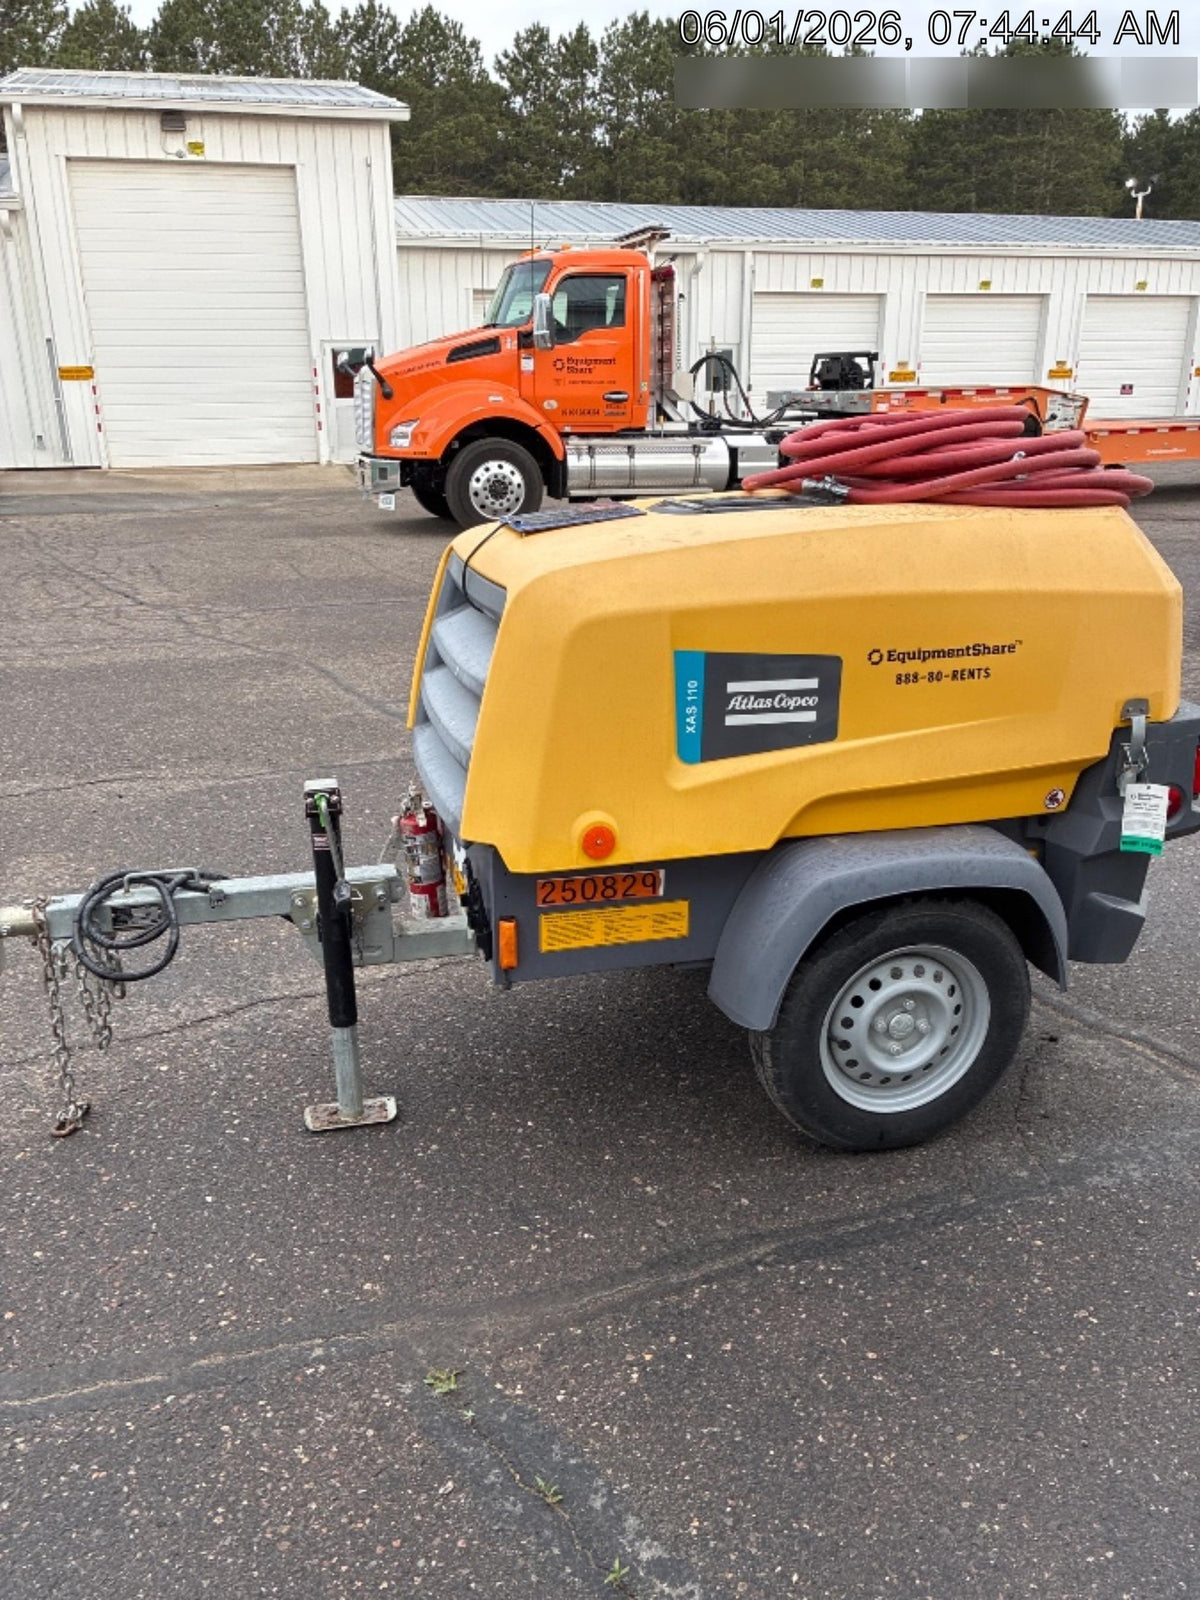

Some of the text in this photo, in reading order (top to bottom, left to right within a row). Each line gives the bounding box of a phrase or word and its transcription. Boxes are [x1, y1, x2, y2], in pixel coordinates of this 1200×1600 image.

[895, 667, 992, 685] 888-80-RENTS
[685, 680, 699, 734] XAS 110
[540, 872, 658, 905] 250829
